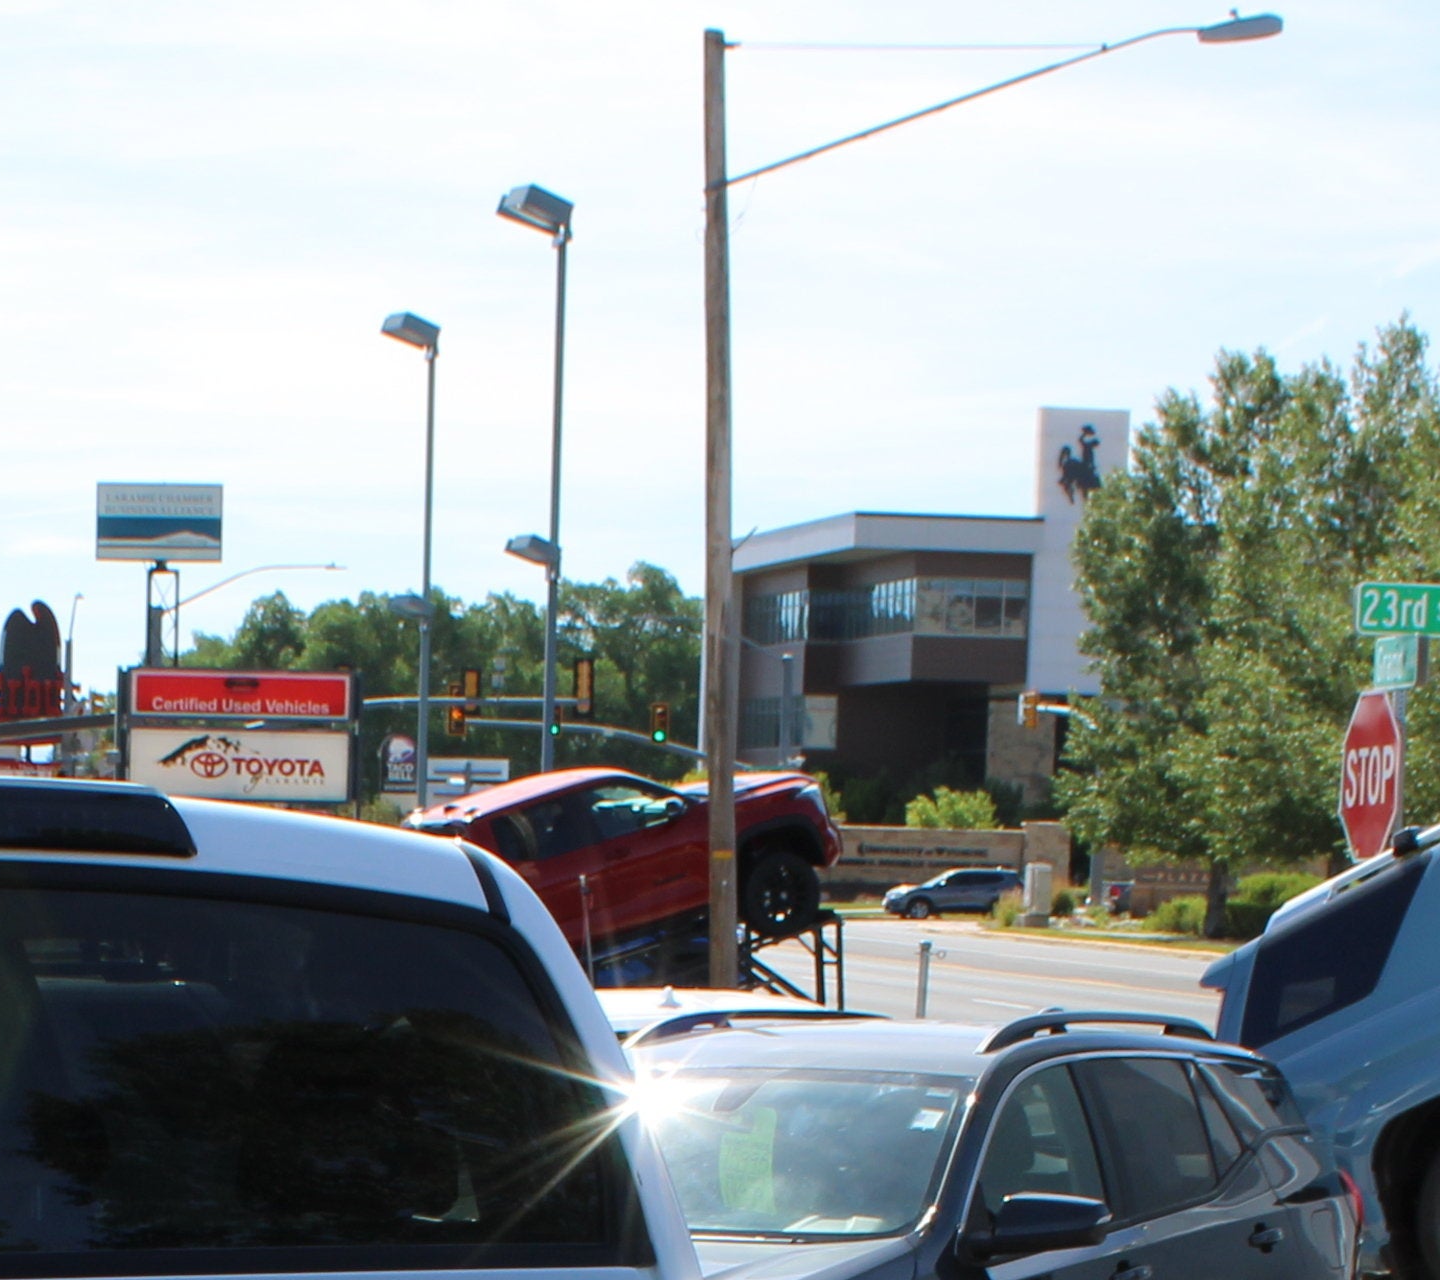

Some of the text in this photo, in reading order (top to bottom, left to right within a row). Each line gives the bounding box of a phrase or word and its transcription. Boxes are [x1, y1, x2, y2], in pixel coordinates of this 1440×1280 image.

[1362, 589, 1429, 629] 23rd
[152, 696, 330, 715] Certified Used Vehicles
[232, 757, 325, 777] TOYOTA
[1345, 744, 1395, 809] STOP
